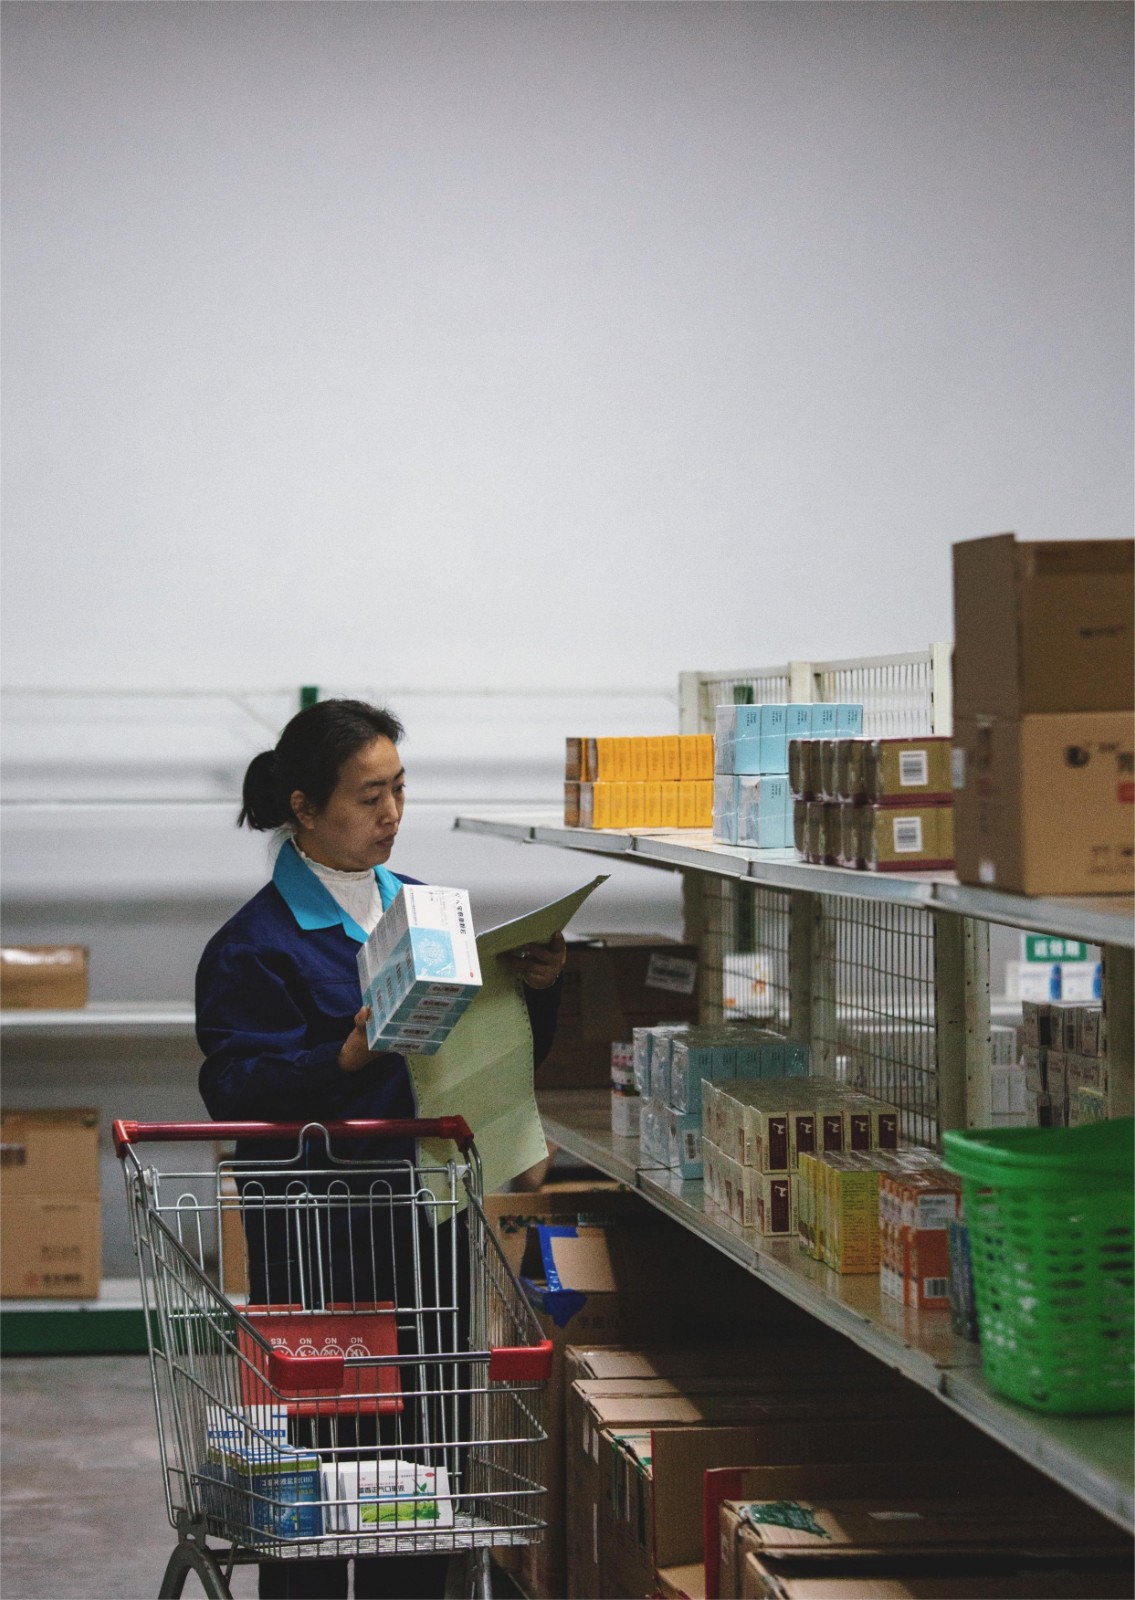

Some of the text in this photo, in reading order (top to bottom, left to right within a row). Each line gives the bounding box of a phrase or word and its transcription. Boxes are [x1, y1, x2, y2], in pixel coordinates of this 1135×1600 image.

[270, 1337, 288, 1345] YES
[299, 1337, 312, 1345] NO
[351, 1336, 363, 1344] NO
